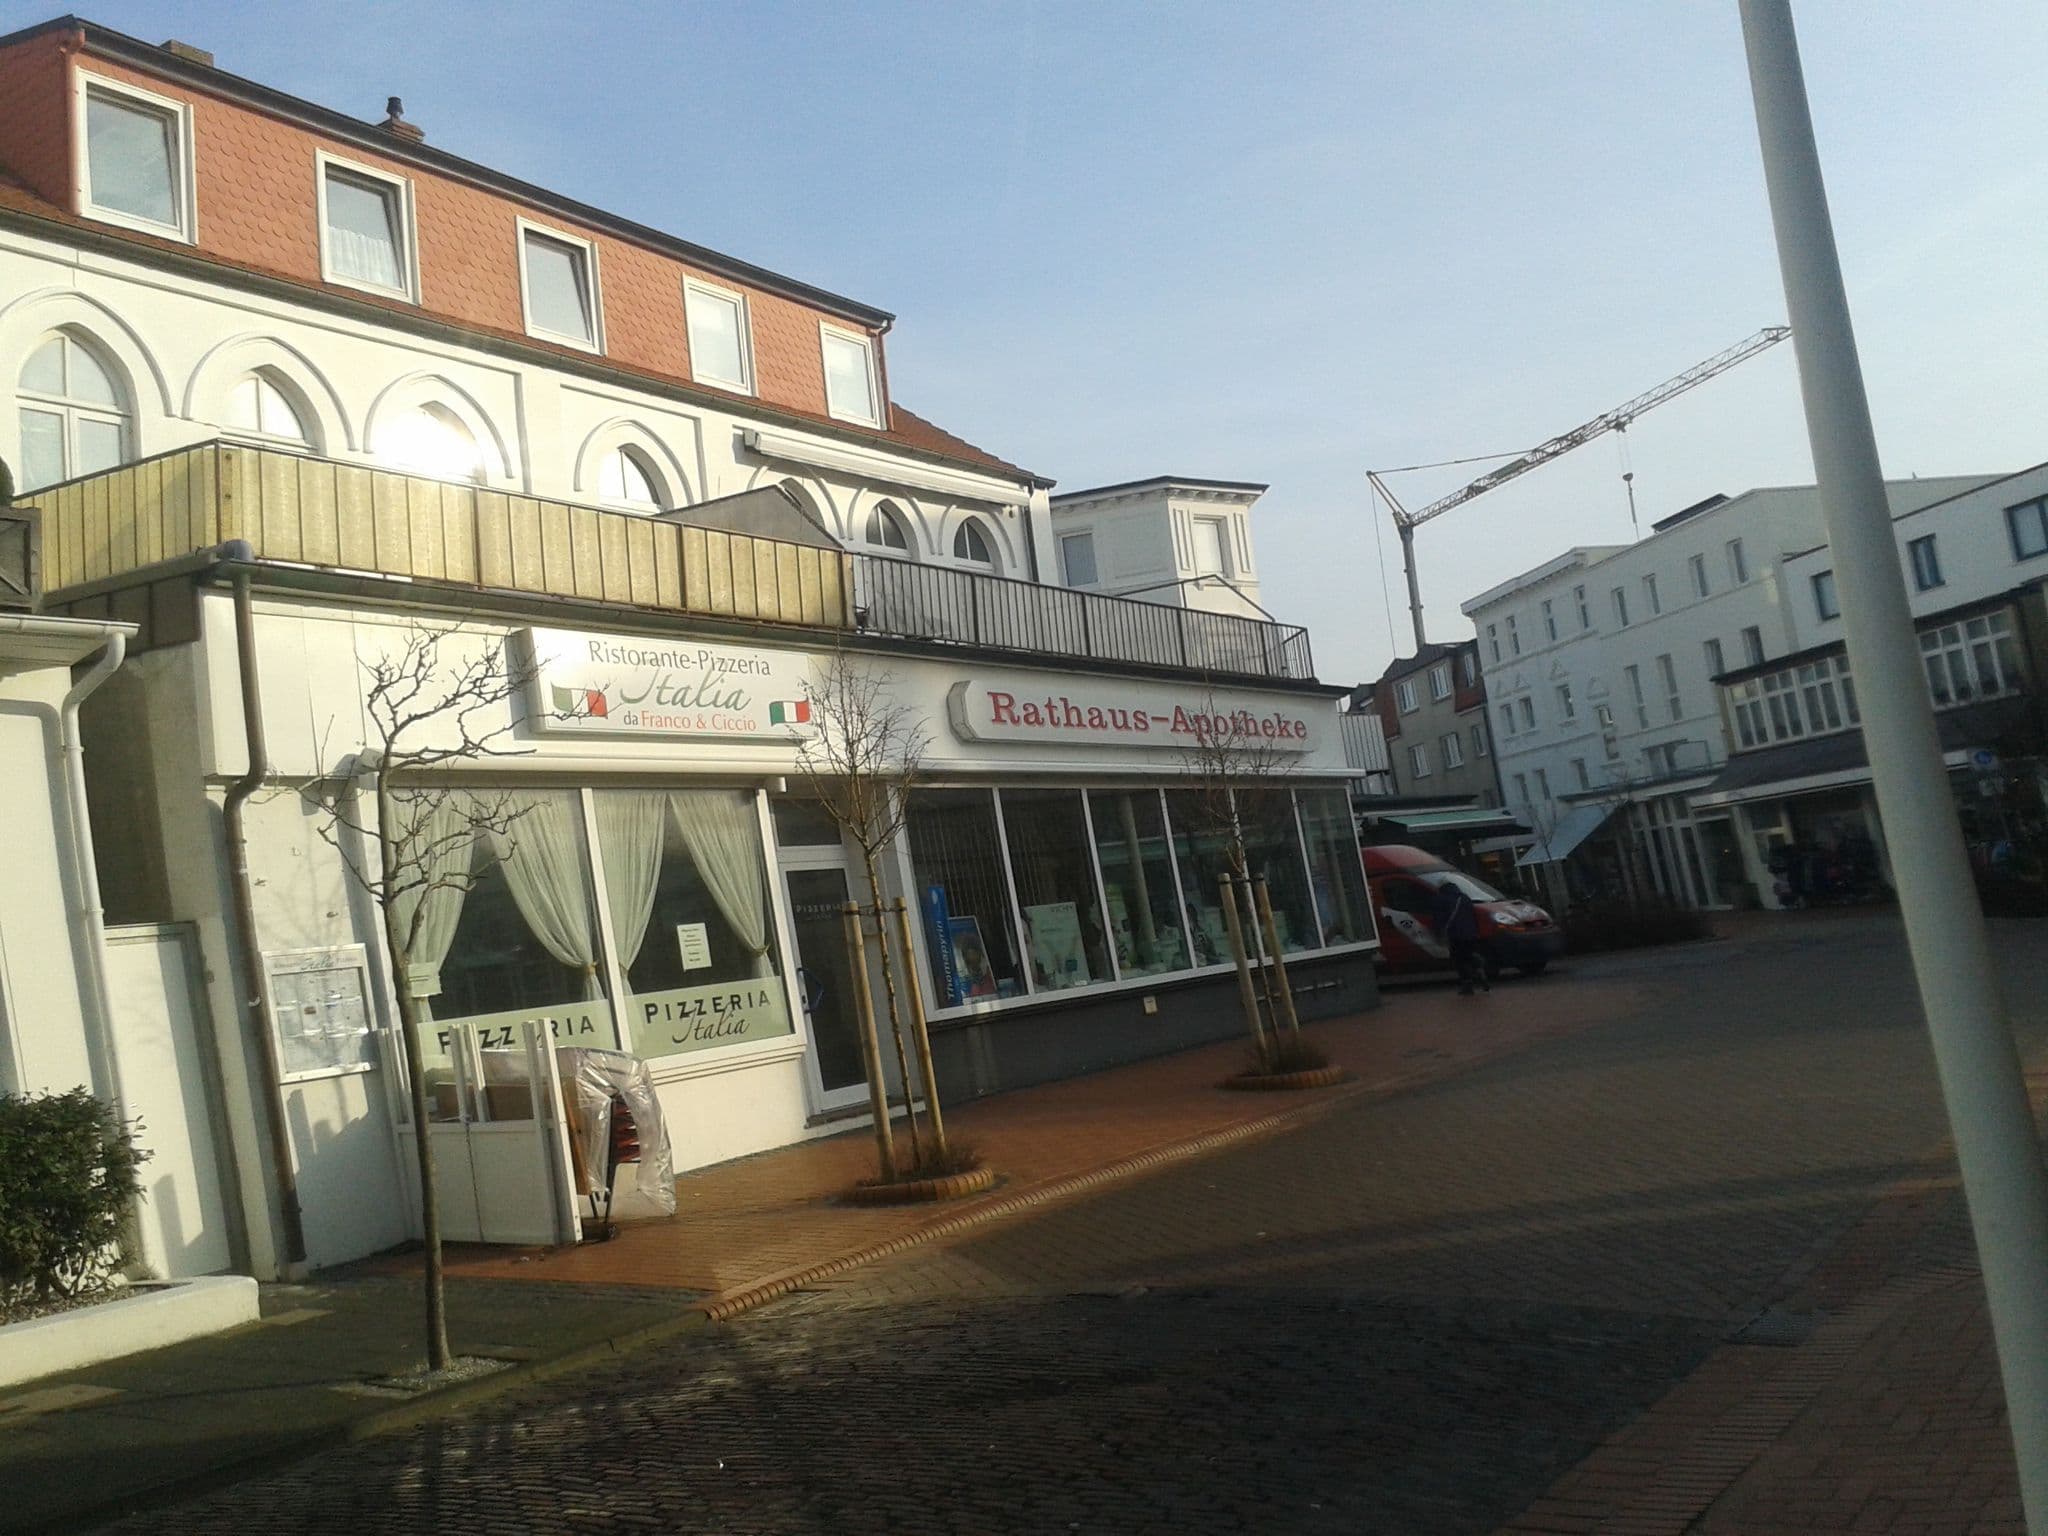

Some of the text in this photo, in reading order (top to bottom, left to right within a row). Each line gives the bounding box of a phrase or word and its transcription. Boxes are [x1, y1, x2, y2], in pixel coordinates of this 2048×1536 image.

[588, 640, 771, 676] Ristorante-Pizzeria
[620, 663, 752, 711] Italia
[623, 710, 757, 732] da Franco & Ciccio
[986, 692, 1307, 744] Rathaus-Apotheke
[936, 920, 954, 1001] Thomapyrin
[644, 989, 771, 1025] PIZZERIA
[672, 1001, 751, 1044] Italia
[436, 1015, 595, 1055] PZZRIA
